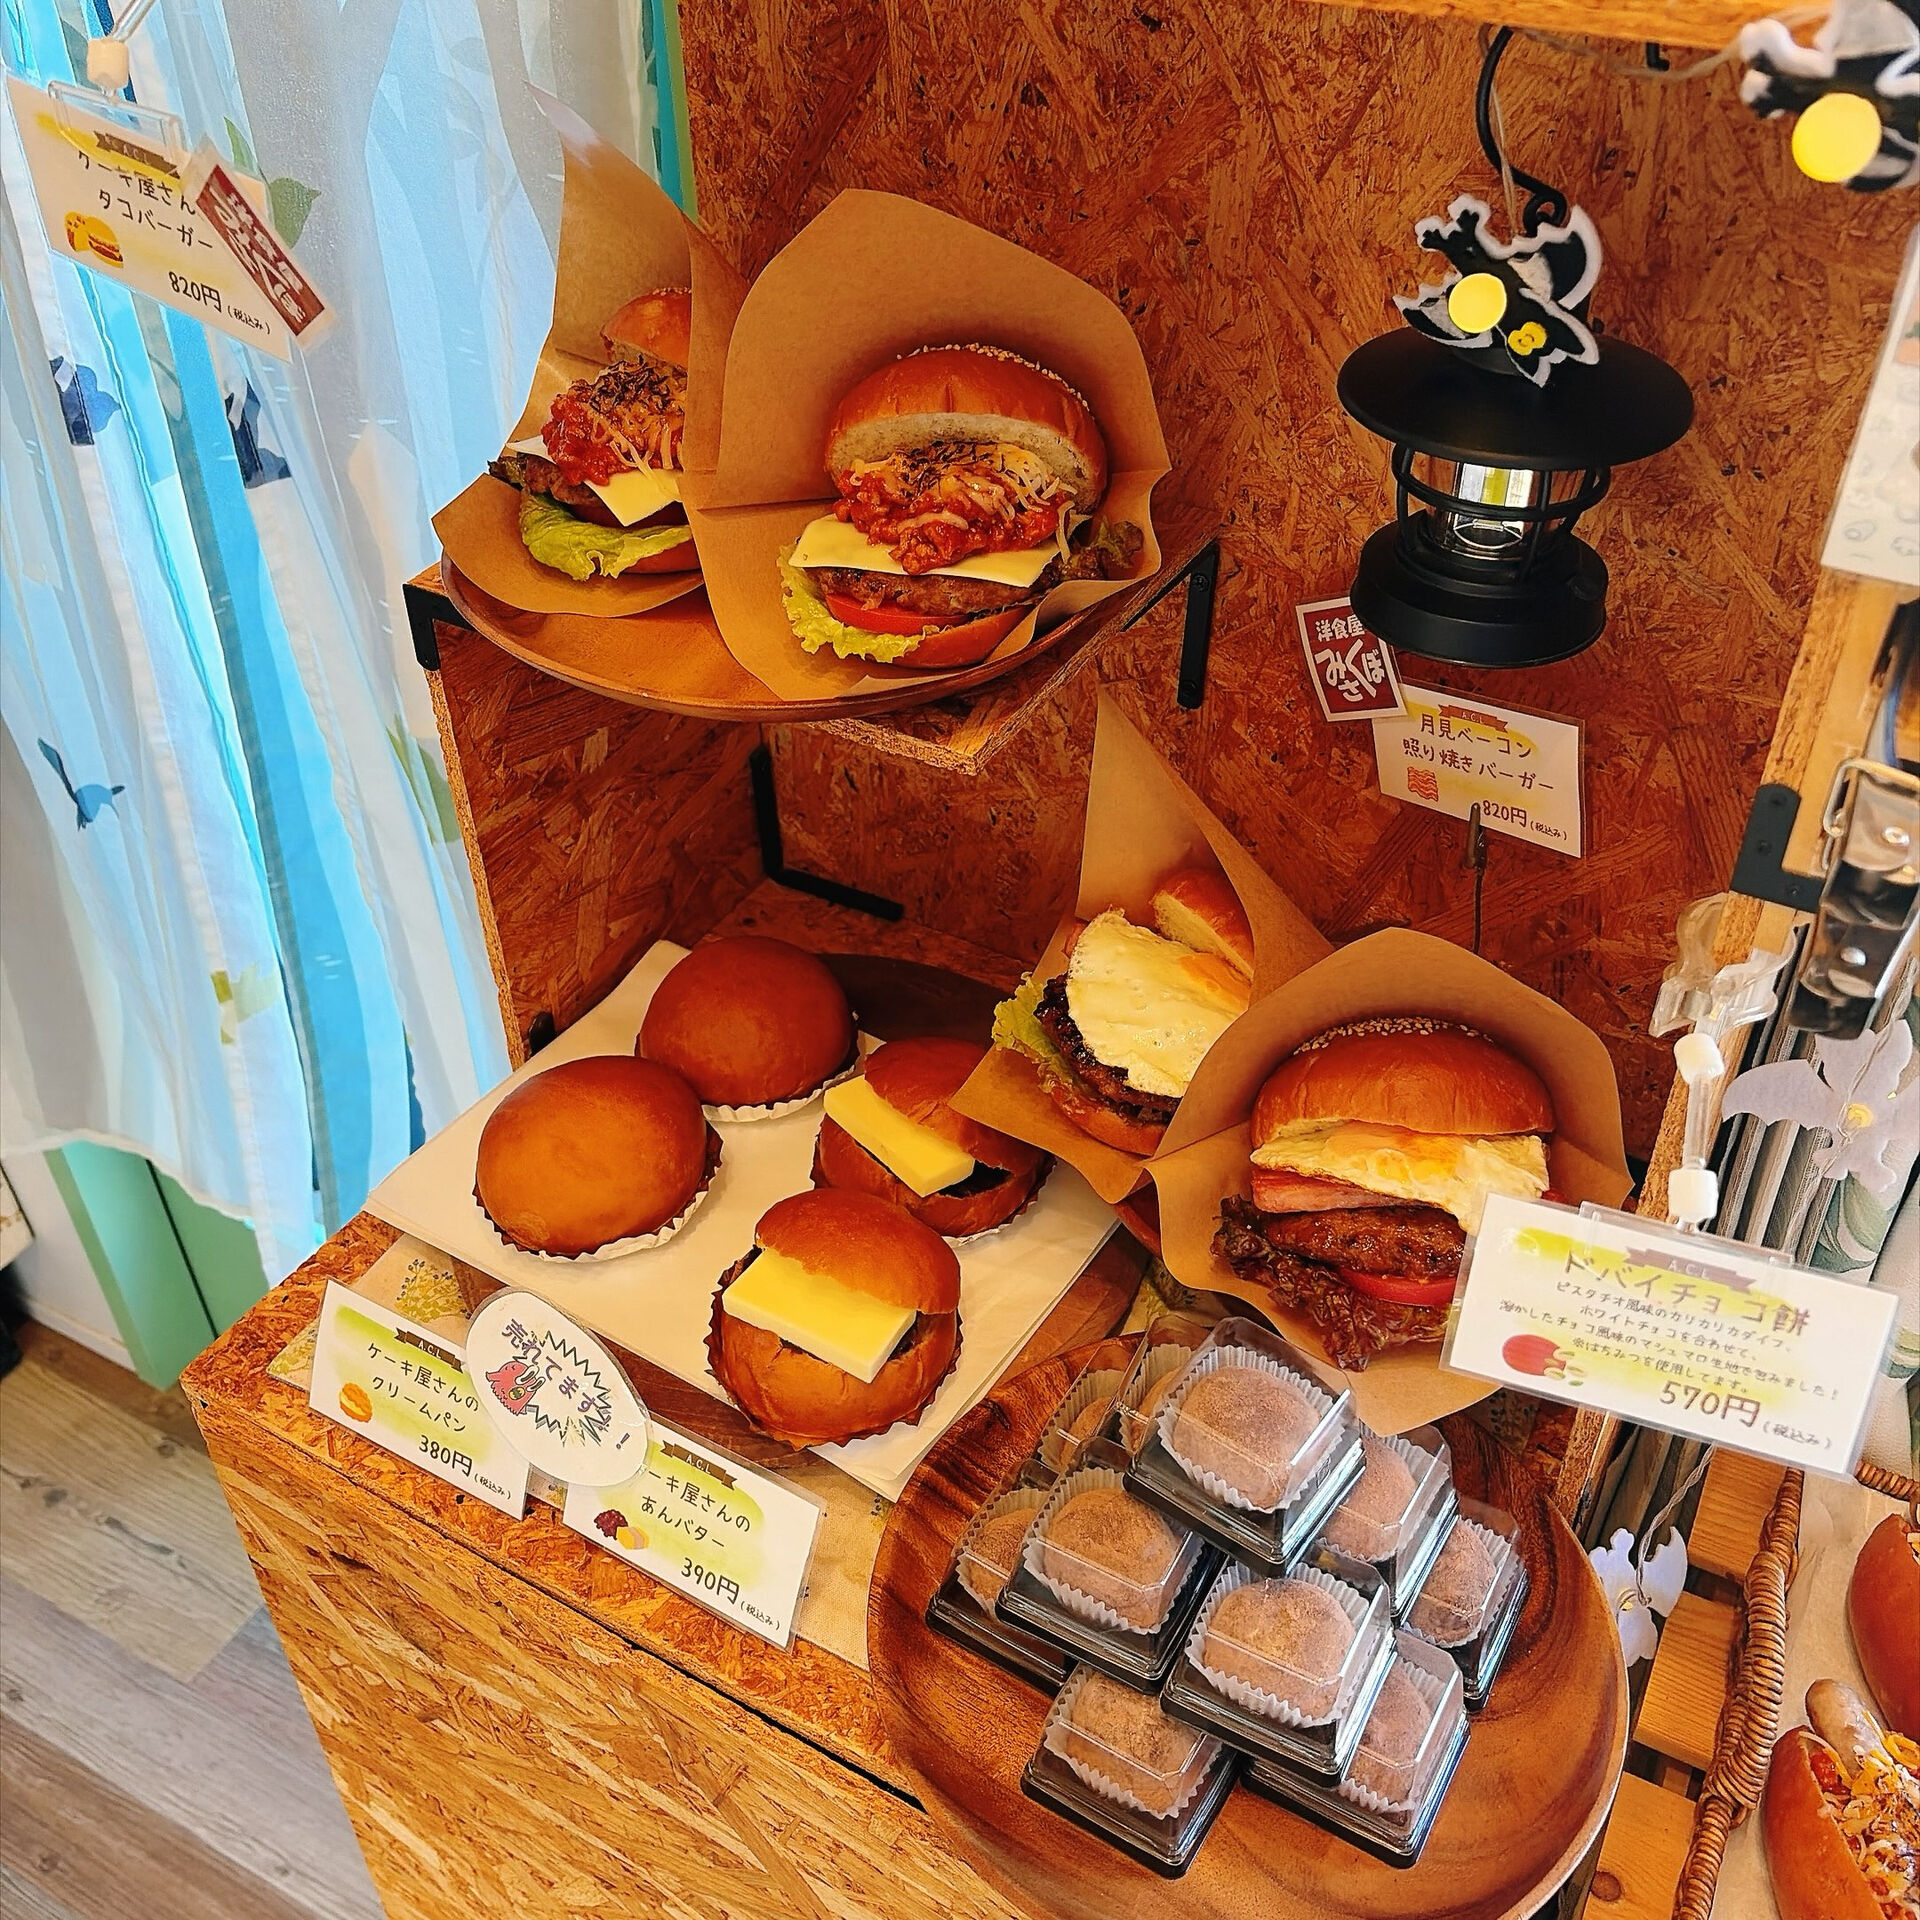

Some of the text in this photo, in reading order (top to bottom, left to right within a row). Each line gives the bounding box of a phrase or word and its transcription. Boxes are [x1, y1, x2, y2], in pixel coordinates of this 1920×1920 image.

[79, 150, 196, 215] ケーキ屋さん
[99, 189, 213, 248] タコバーガー
[169, 271, 222, 313] 820円
[1315, 614, 1366, 642] 洋食屋
[1420, 713, 1532, 758] 月見ベーコン
[1402, 737, 1554, 790] 照り焼きバーガー
[1482, 800, 1527, 828] 820円
[1564, 1249, 1811, 1336] ドバイチョコ餅
[368, 1343, 480, 1412] ケーキ屋さんの
[372, 1376, 466, 1432] クリームパン
[1659, 1380, 1761, 1428] 570円
[418, 1434, 473, 1477] 380円
[641, 1495, 725, 1547] あんバター
[647, 1470, 751, 1532] ーキ屋さんの
[681, 1557, 740, 1605] 390円
